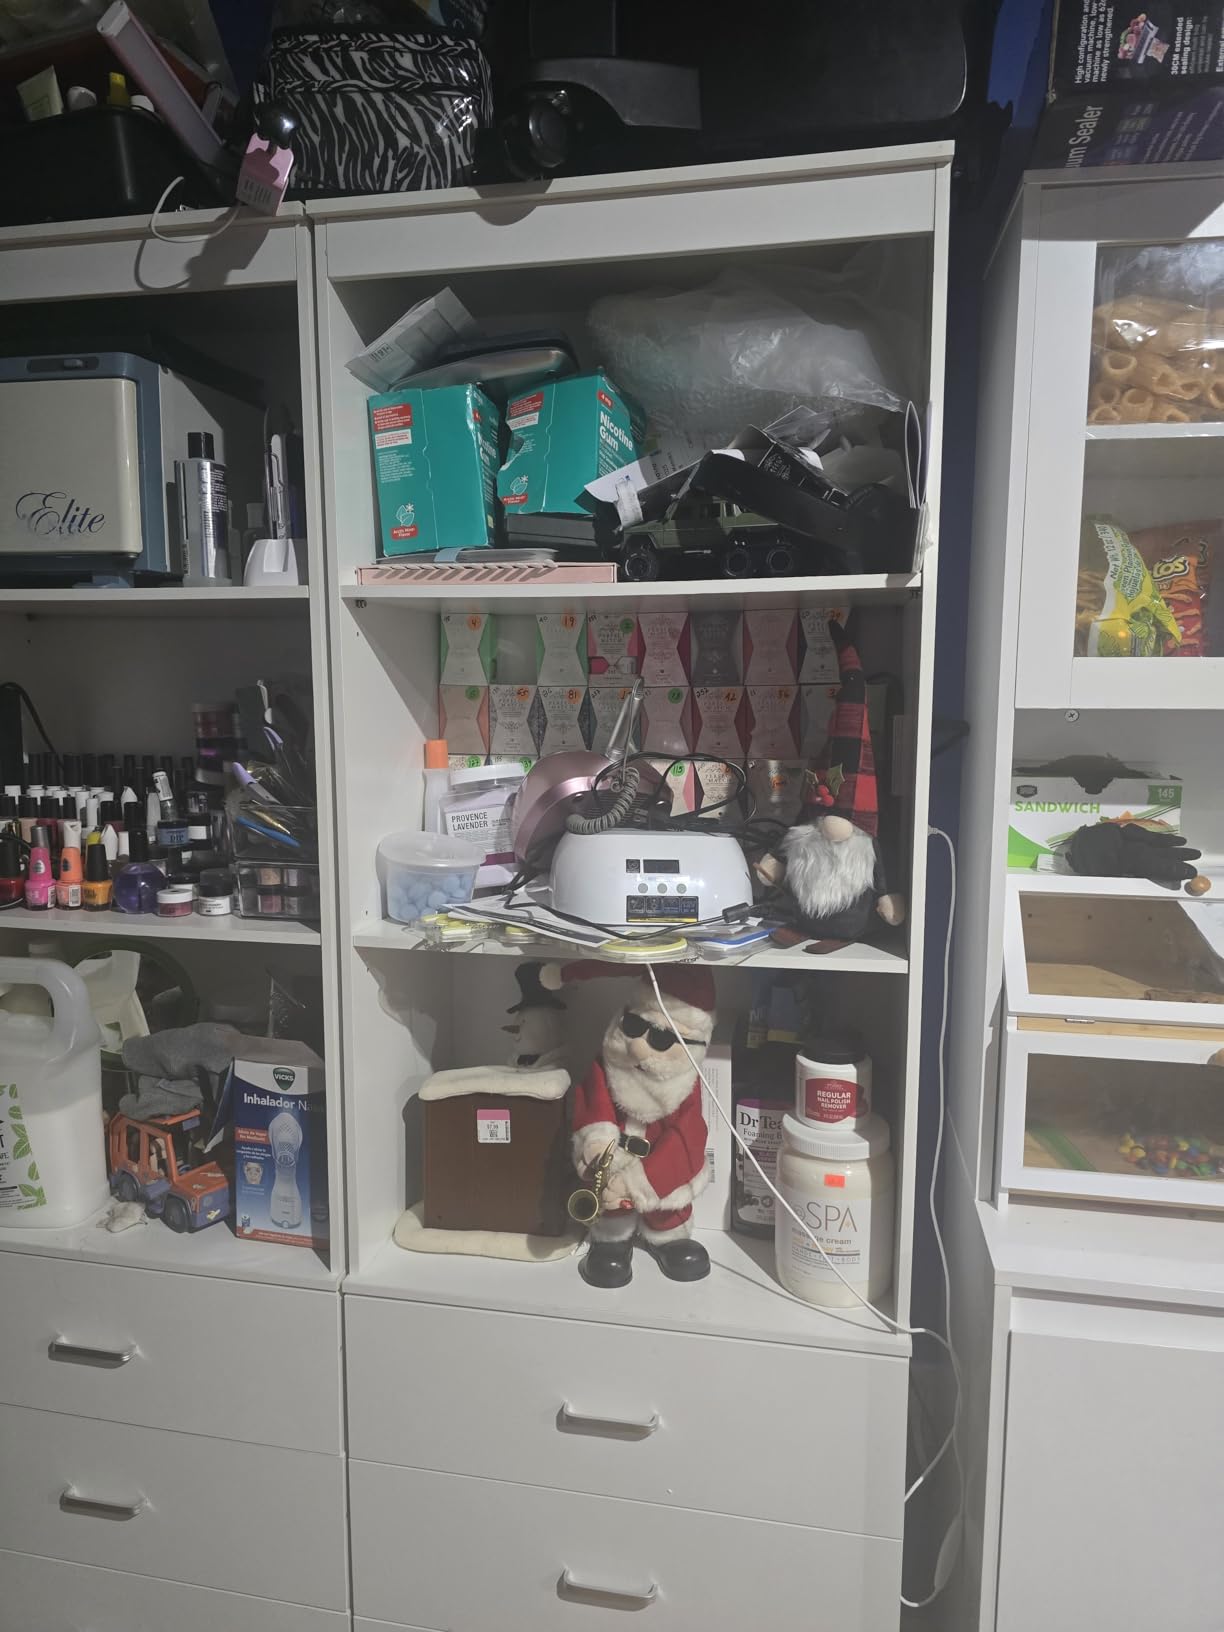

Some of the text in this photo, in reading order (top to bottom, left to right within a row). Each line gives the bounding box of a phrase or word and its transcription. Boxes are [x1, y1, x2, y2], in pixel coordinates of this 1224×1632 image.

[1078, 15, 1089, 64] configuration
[1096, 25, 1104, 38] low
[1174, 17, 1184, 52] extended
[1084, 54, 1093, 83] vacuum
[1092, 51, 1101, 82] machine
[1180, 47, 1190, 75] sealing
[1074, 66, 1084, 84] High
[1100, 59, 1110, 82] newly
[1068, 105, 1104, 144] Sealer
[600, 410, 633, 451] Nicotine
[600, 426, 618, 451] Gum
[15, 491, 106, 536] Elite
[568, 690, 578, 700] 81
[1158, 788, 1174, 799] 145
[1015, 800, 1100, 814] SANDWICH
[451, 812, 488, 823] PROVENCE
[452, 820, 488, 832] LAVENDER
[274, 1073, 294, 1082] VICKS
[244, 1093, 296, 1109] Inhalador
[816, 1090, 852, 1099] REGULAR
[740, 1112, 783, 1130] Dr Tea
[744, 1128, 774, 1140] Foaming
[806, 1202, 858, 1232] SPA
